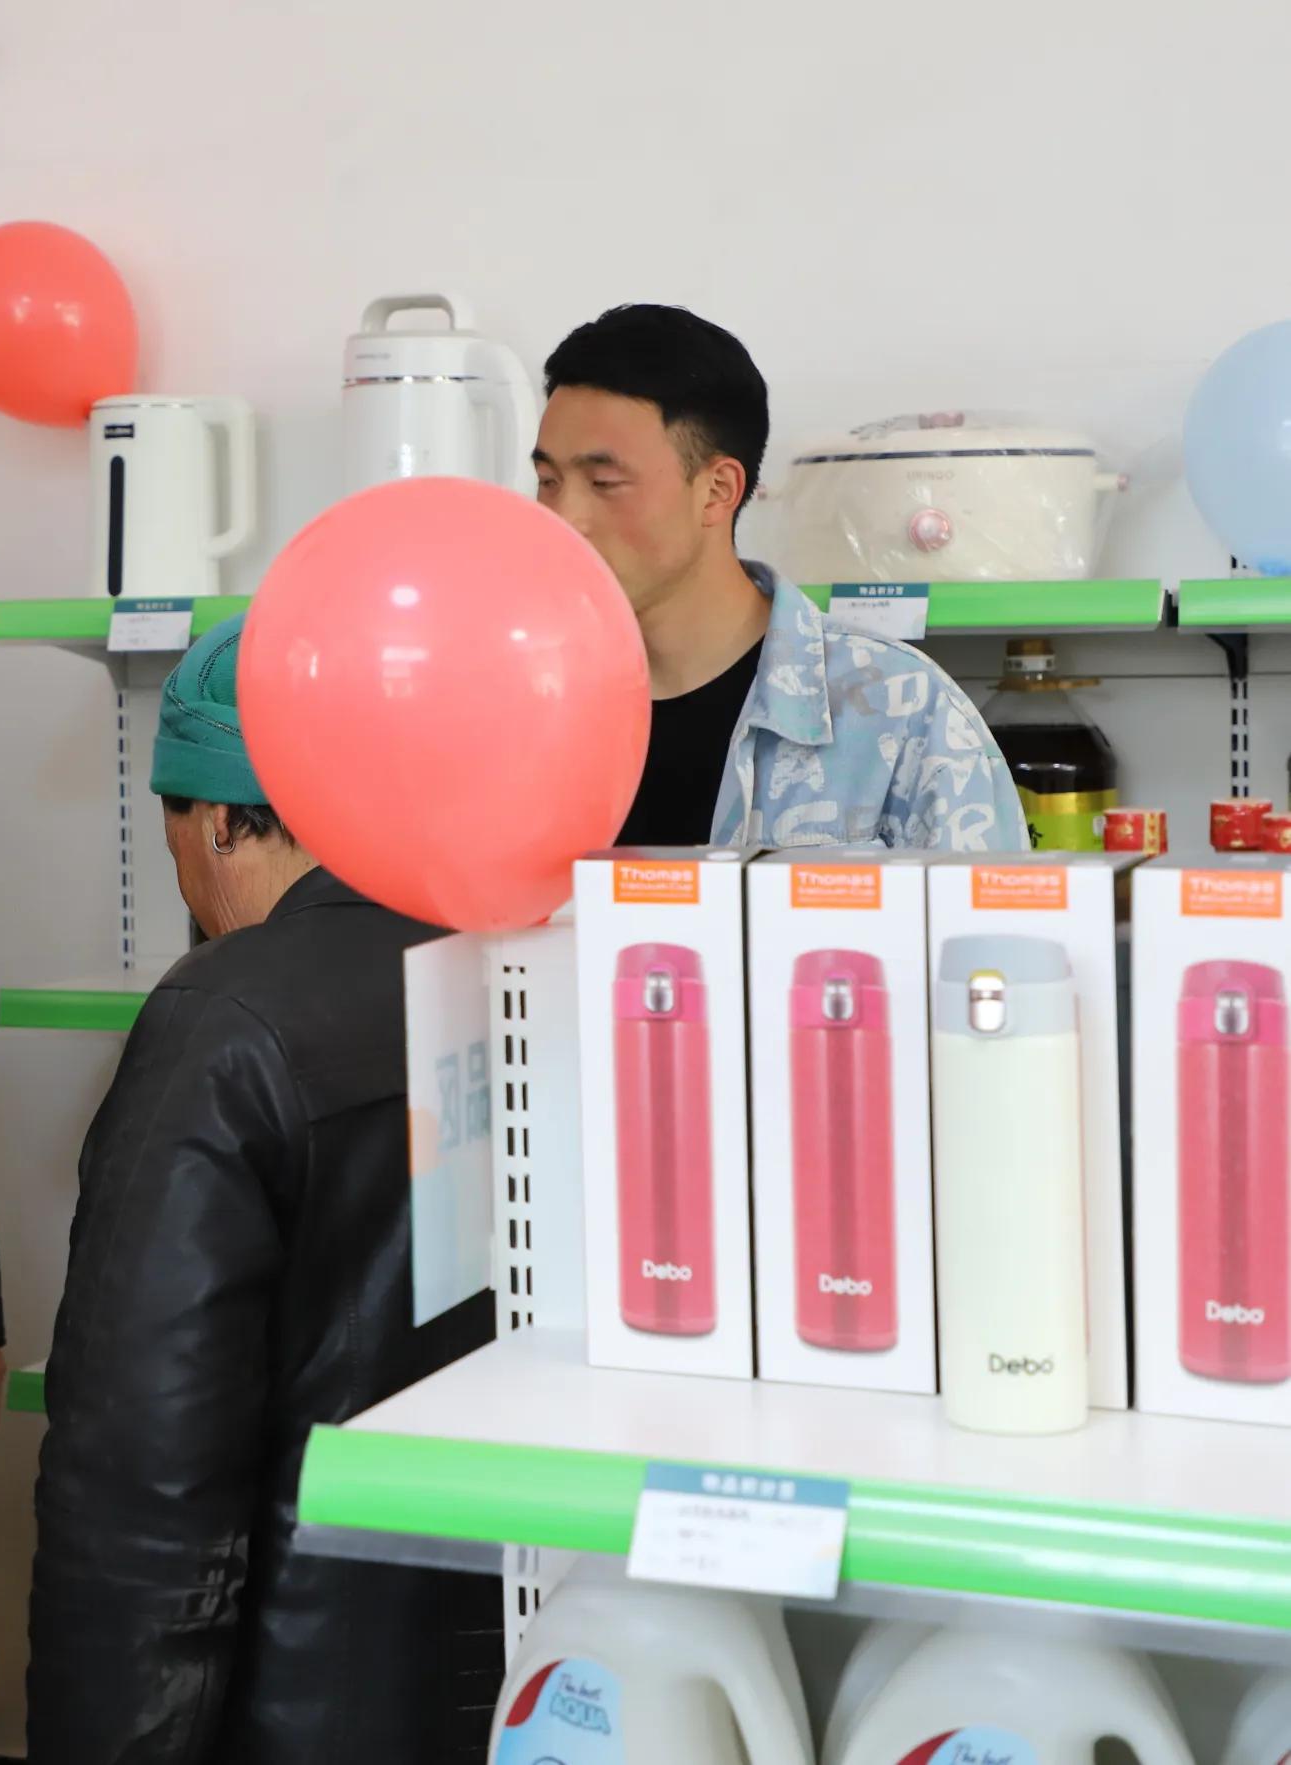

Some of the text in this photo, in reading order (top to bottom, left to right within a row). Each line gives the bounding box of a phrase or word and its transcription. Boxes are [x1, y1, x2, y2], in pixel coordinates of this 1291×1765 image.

[642, 1259, 692, 1281] Debo
[818, 1273, 873, 1296] Debo
[1204, 1300, 1265, 1324] Debo
[988, 1353, 1054, 1375] Debo
